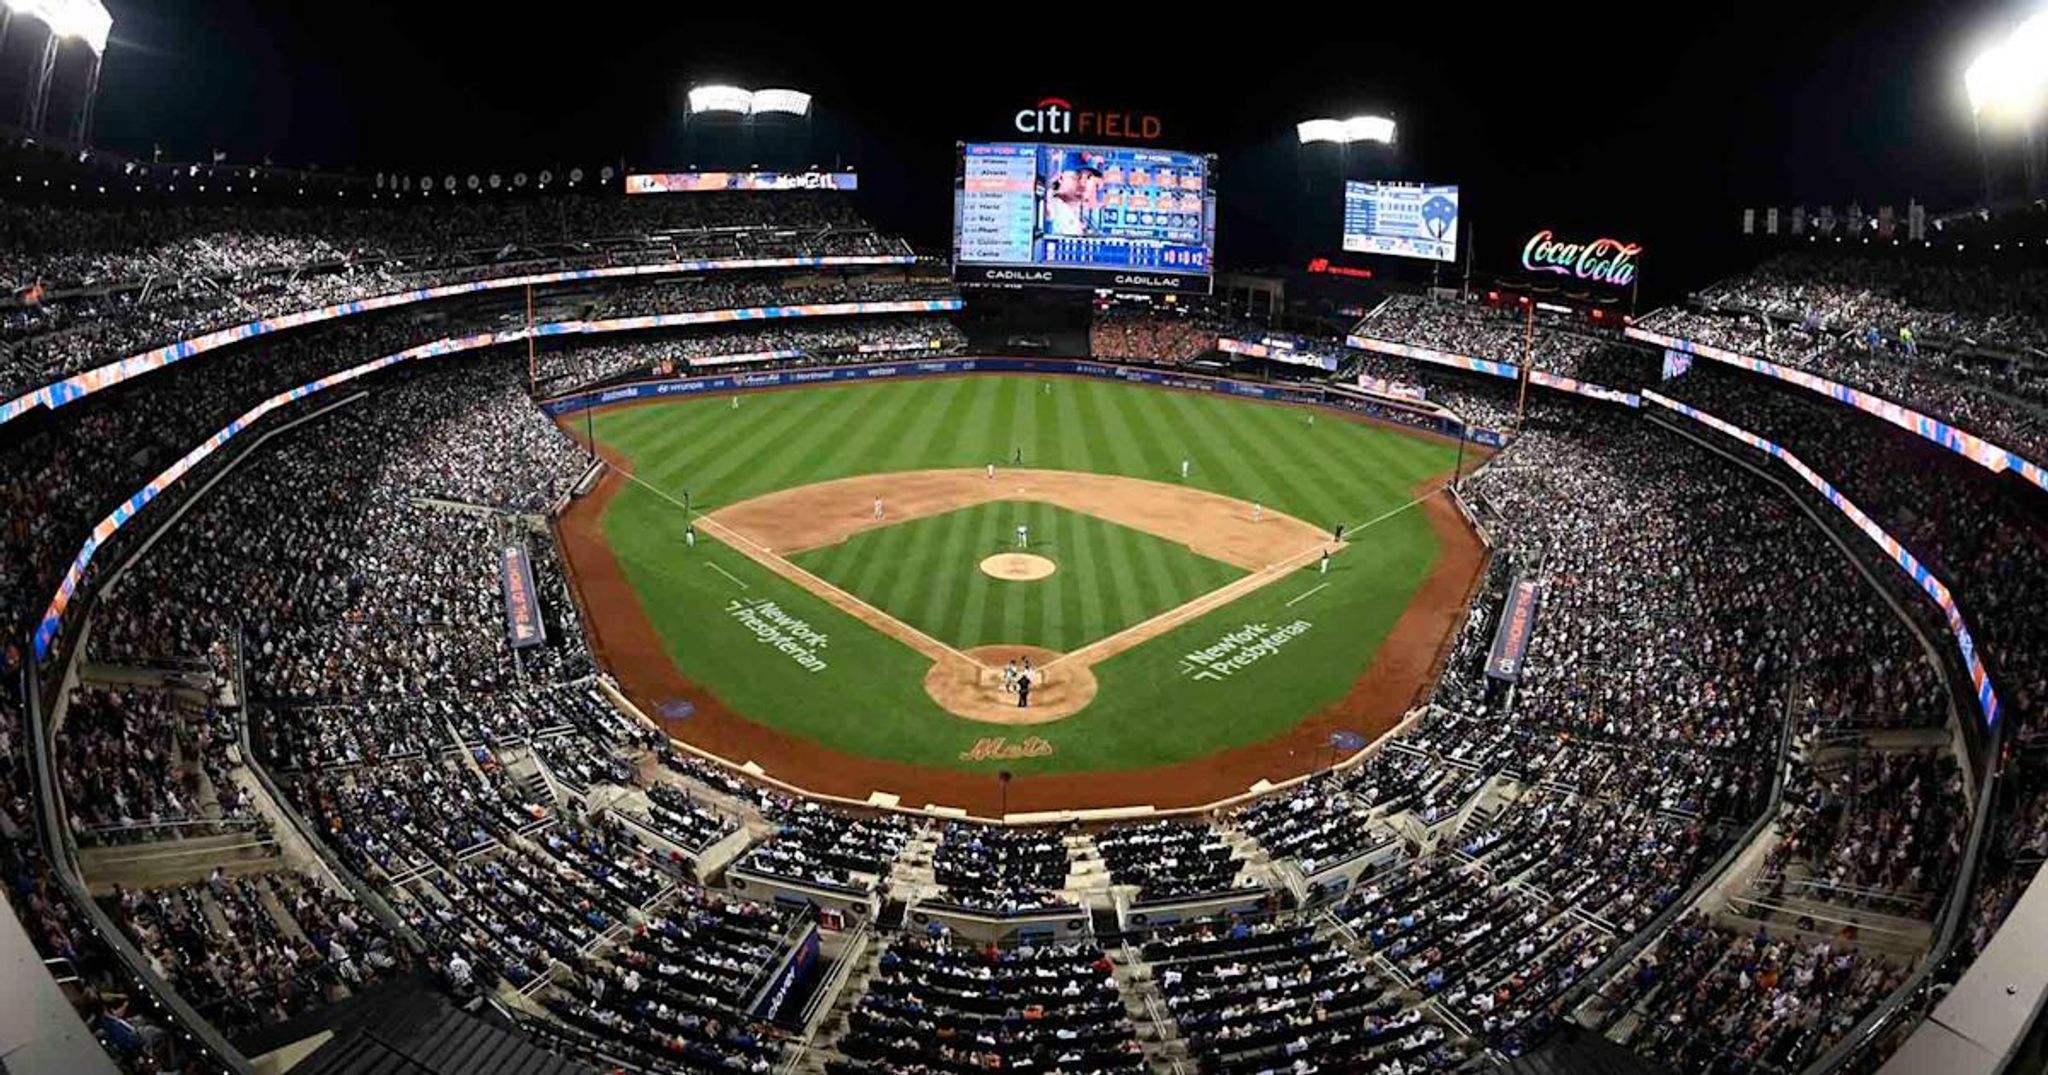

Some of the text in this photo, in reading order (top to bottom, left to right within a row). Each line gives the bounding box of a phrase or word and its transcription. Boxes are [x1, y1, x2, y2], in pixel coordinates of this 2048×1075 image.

[1015, 104, 1162, 139] citi FIELD
[985, 269, 1053, 281] CADILLAC
[1114, 275, 1181, 288] CADILLAC
[732, 608, 828, 673] Presbyterian
[1209, 619, 1313, 675] Presbyterian
[958, 736, 1054, 762] Mets
